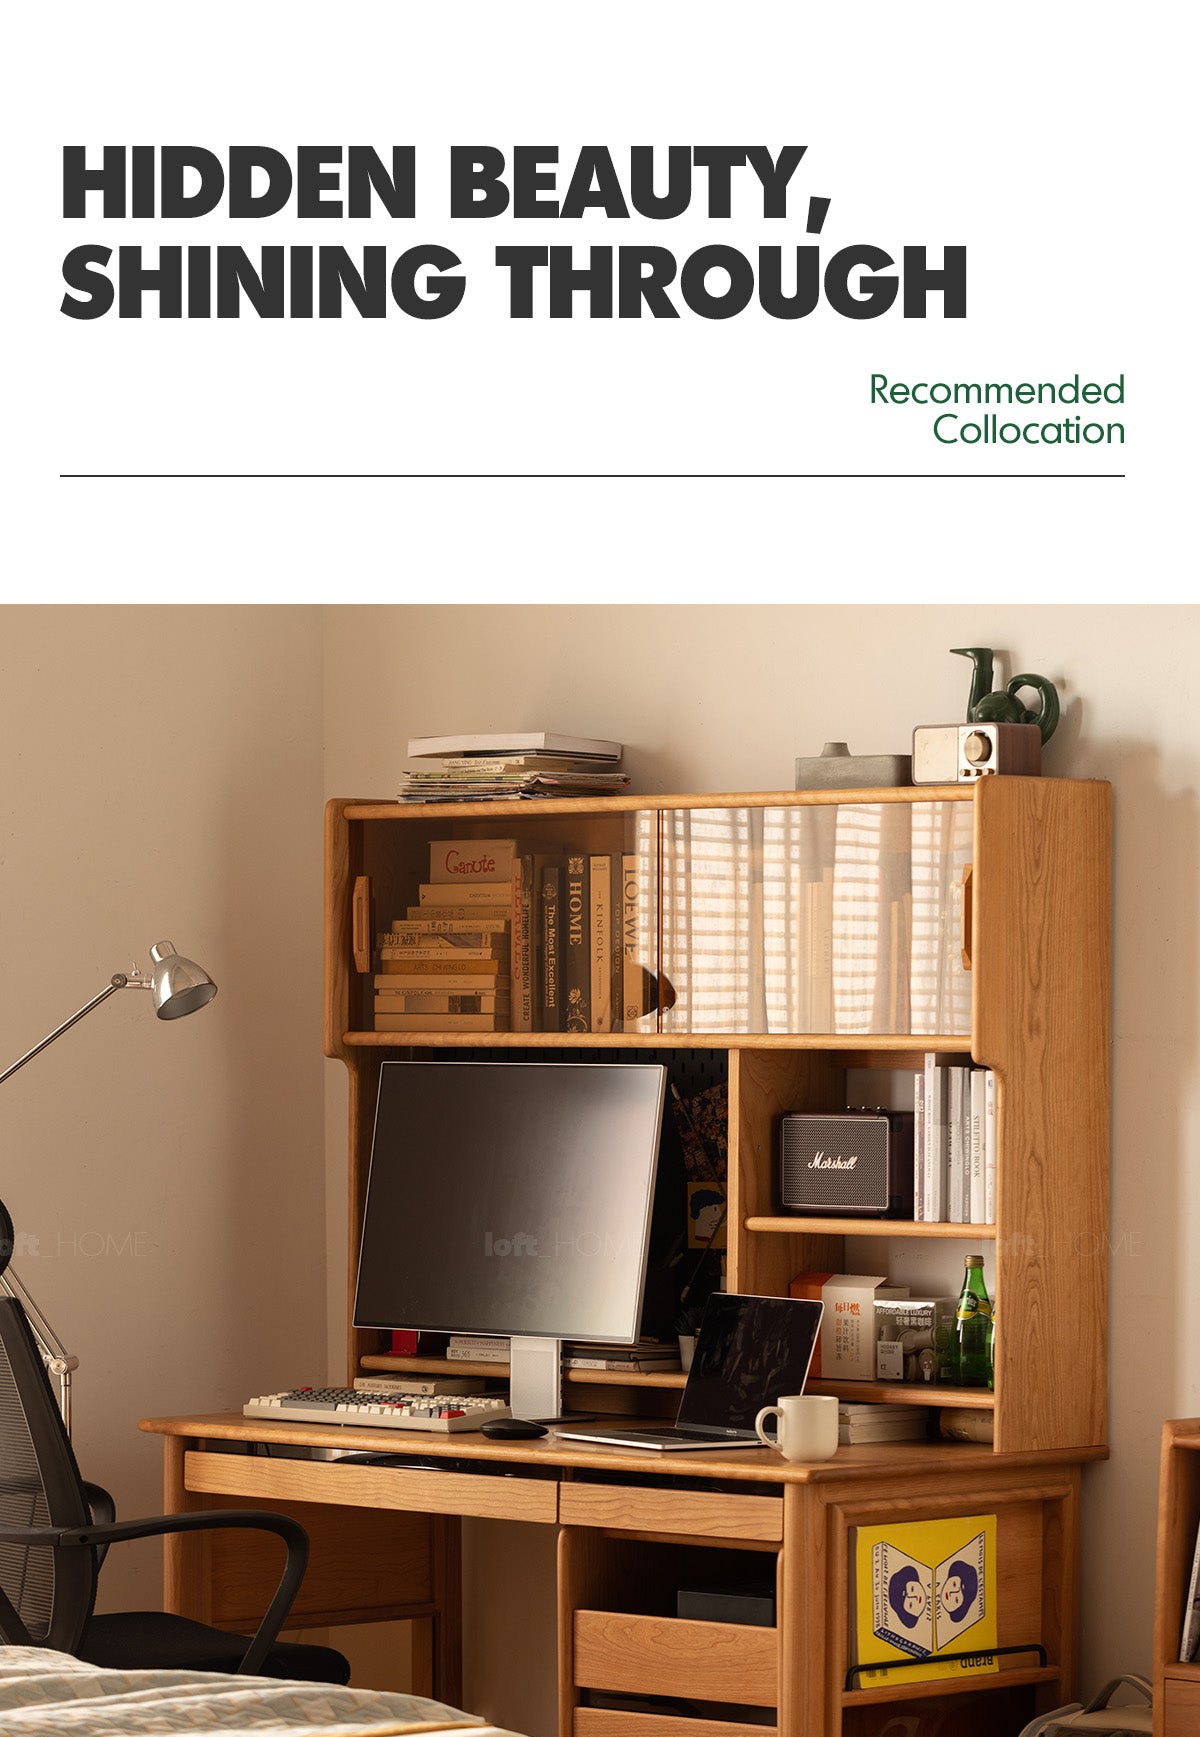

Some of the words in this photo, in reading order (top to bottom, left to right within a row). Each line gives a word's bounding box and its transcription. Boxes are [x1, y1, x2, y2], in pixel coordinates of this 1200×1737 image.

[445, 850, 496, 874] Canute
[568, 881, 583, 946] HOME
[807, 1152, 858, 1170] Marshall
[909, 1308, 933, 1317] LUXURY
